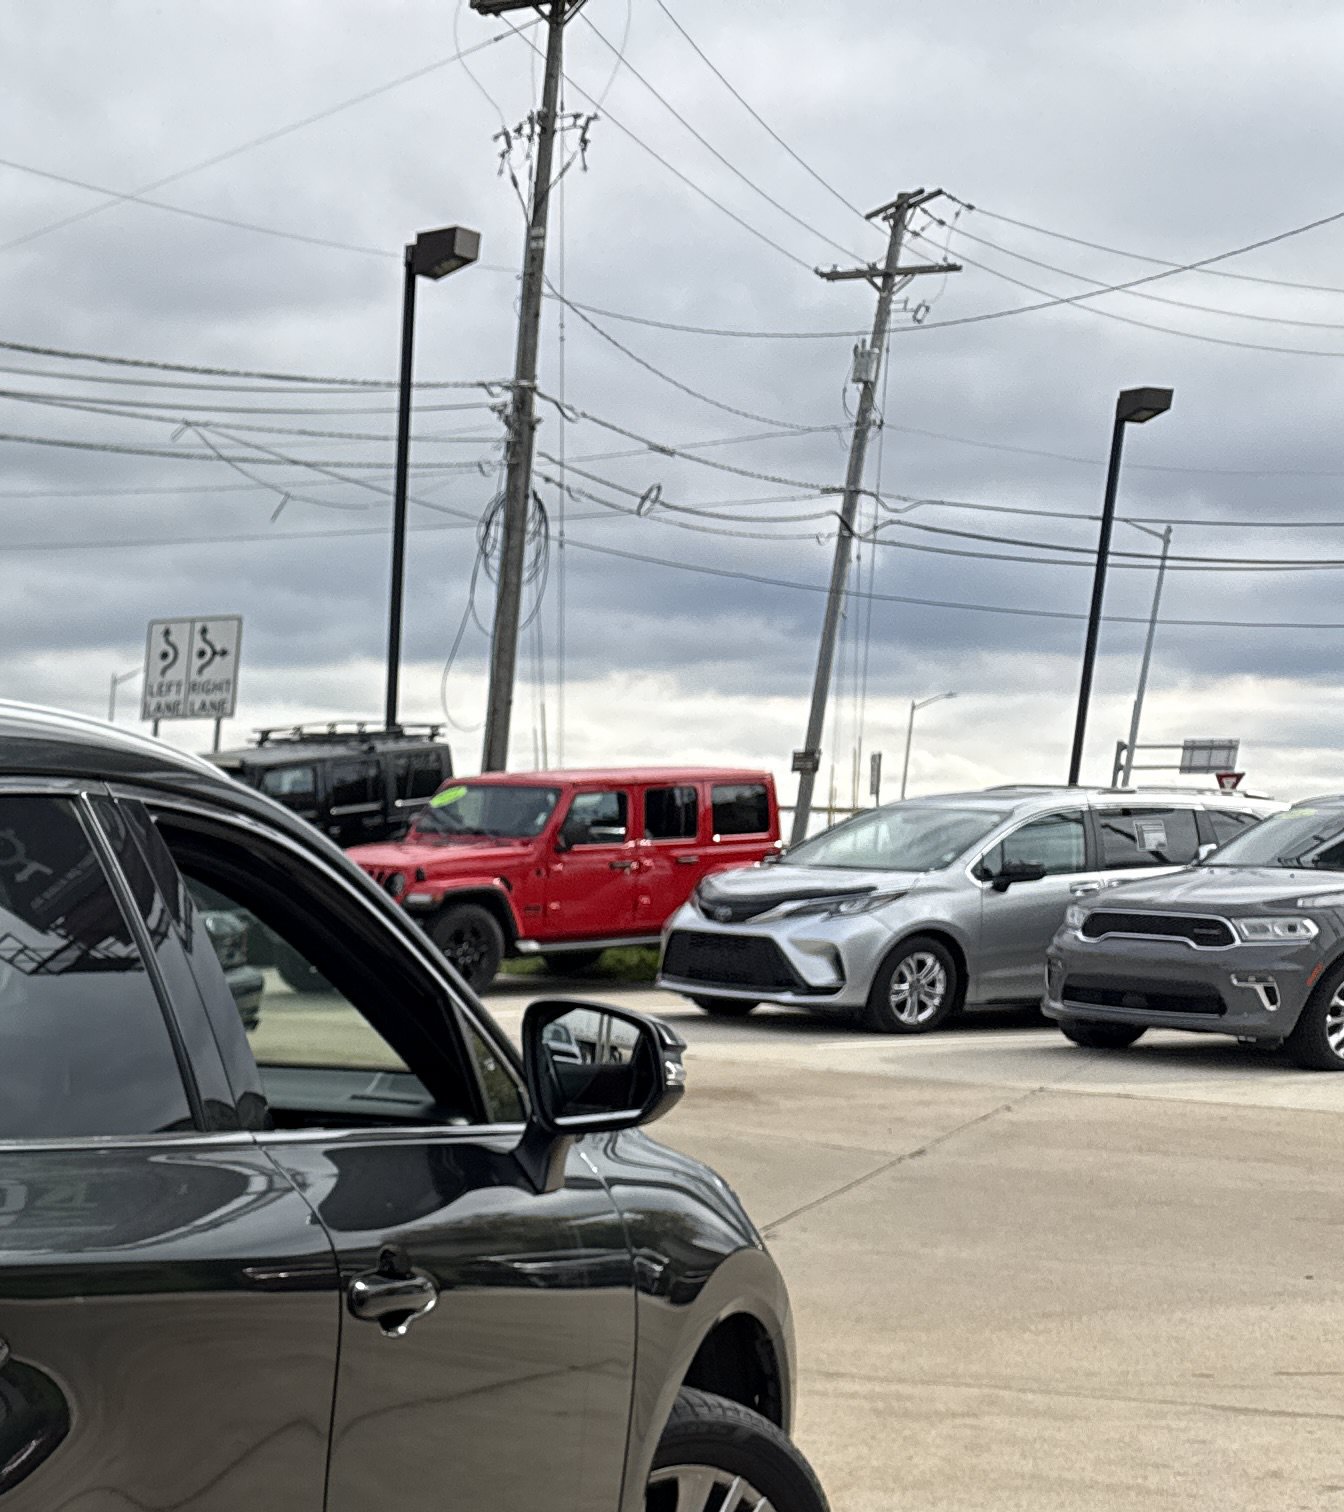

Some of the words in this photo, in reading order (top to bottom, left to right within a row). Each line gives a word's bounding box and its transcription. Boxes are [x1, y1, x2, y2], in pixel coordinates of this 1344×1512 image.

[147, 679, 183, 697] LEFT
[190, 678, 232, 696] RIGHT
[144, 700, 180, 715] LANE
[189, 700, 227, 714] LANE
